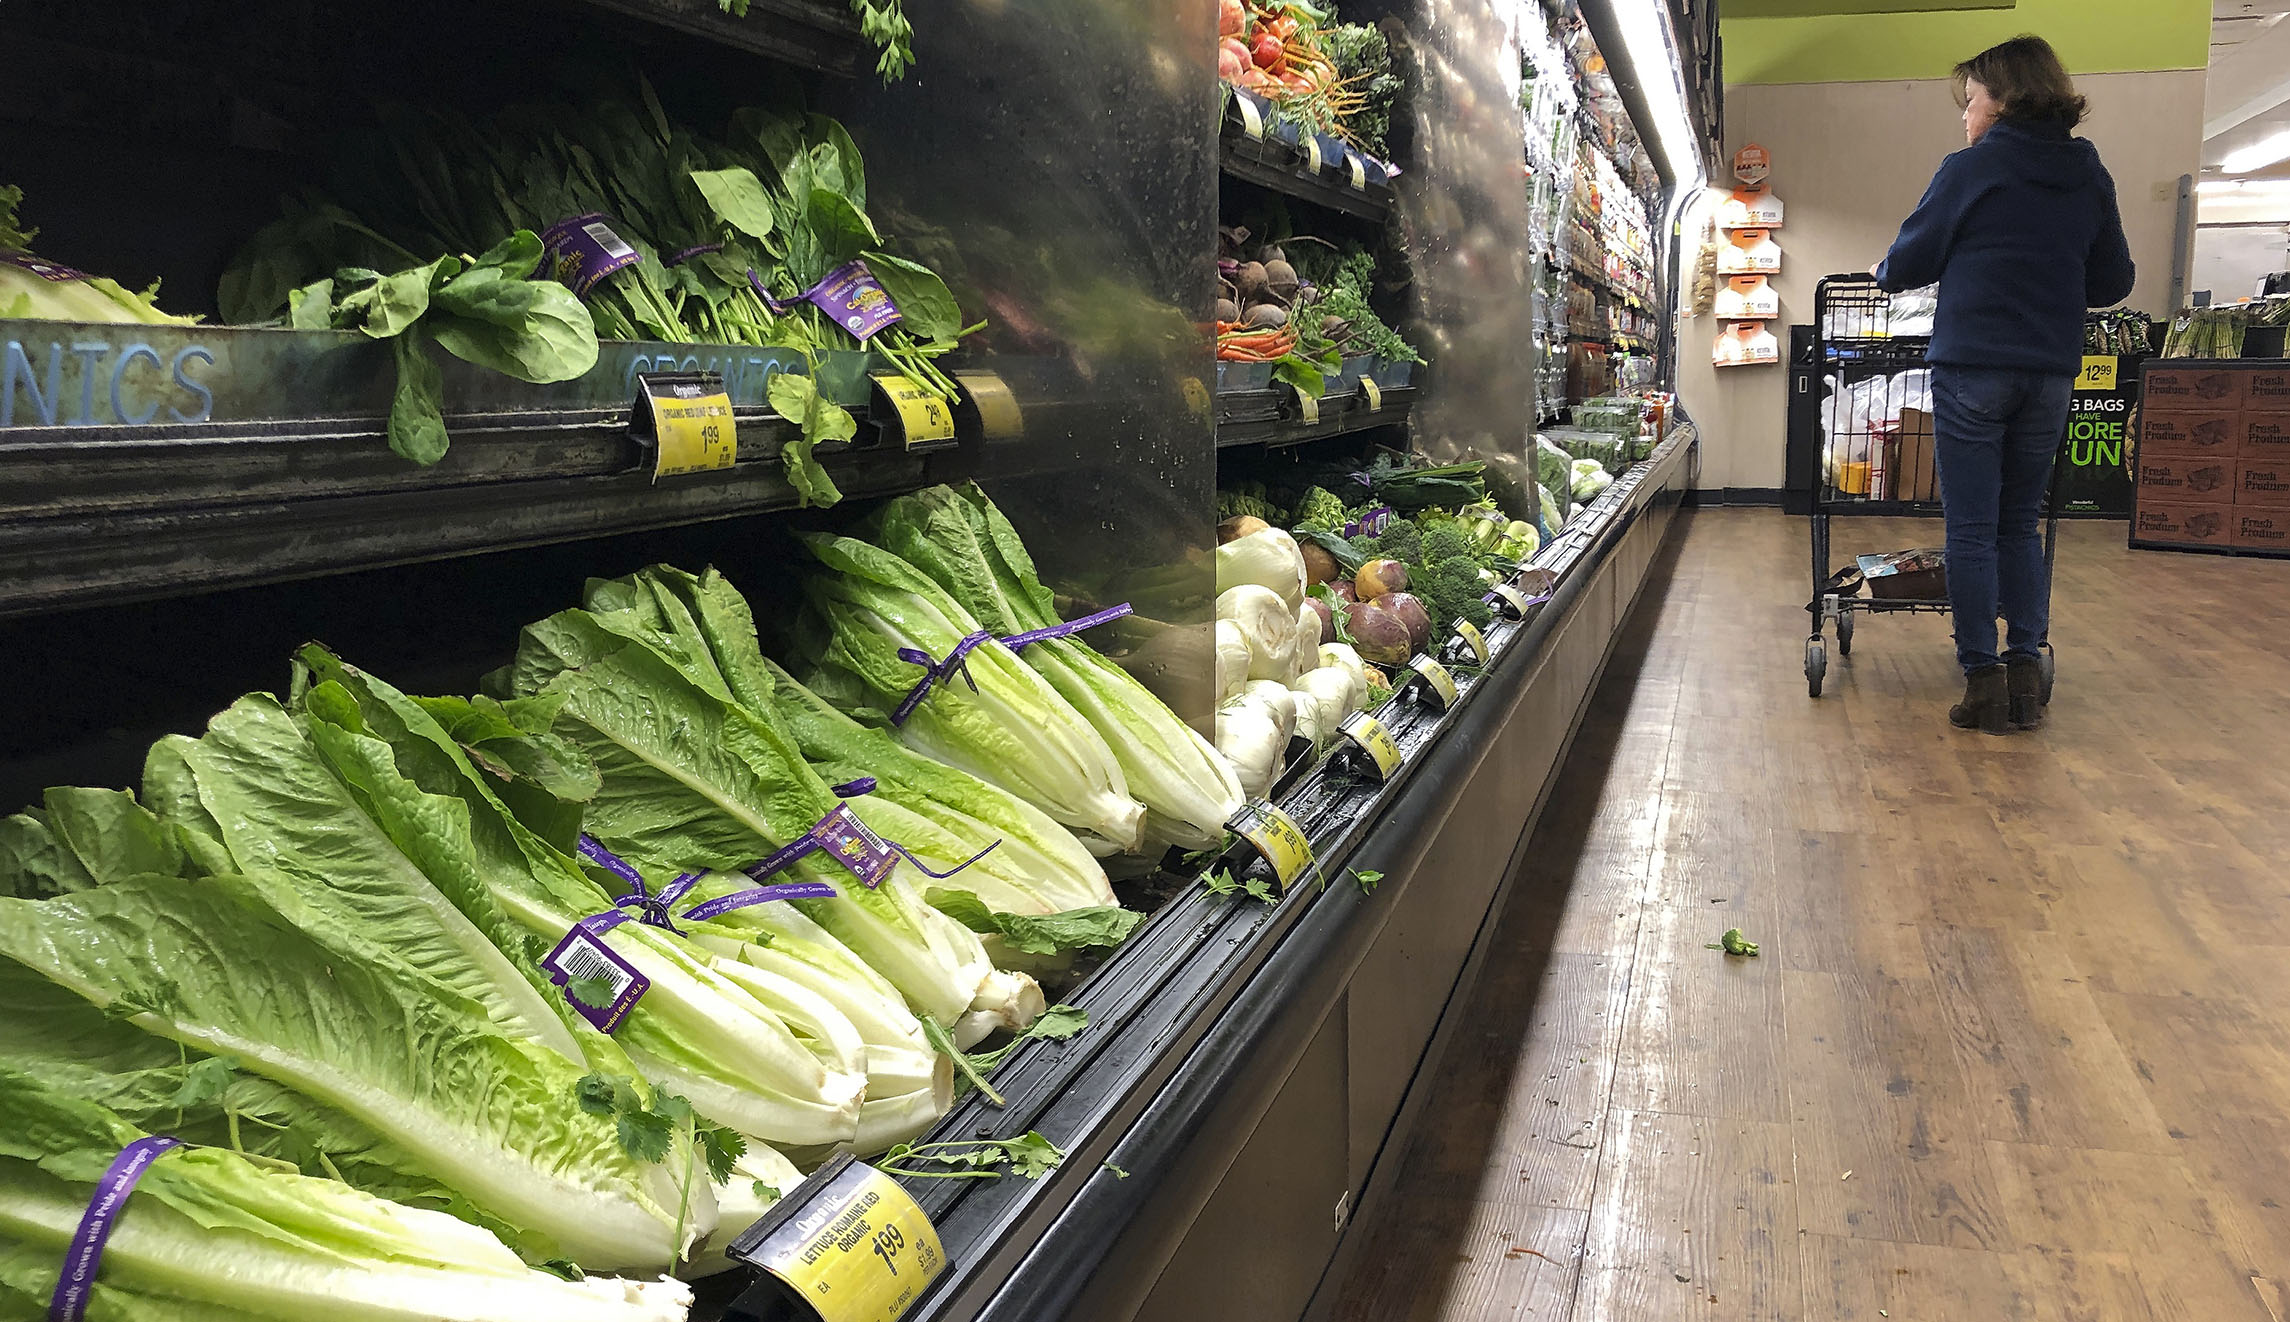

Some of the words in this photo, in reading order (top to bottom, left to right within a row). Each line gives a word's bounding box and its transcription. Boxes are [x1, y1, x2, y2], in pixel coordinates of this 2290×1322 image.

[673, 384, 702, 398] Organic
[2084, 399, 2125, 411] BAGS
[2075, 412, 2101, 421] HAVE
[2068, 421, 2122, 440] ORE
[2065, 440, 2121, 466] UN
[704, 903, 720, 914] Pride
[601, 1011, 620, 1033] Produit
[618, 1001, 630, 1013] des
[72, 1245, 94, 1282] Grown
[87, 1220, 103, 1243] with
[95, 1192, 118, 1217] Pride
[112, 1174, 129, 1192] and
[800, 1229, 838, 1266] LETTUCE
[833, 1202, 869, 1236] ROMAINE
[862, 1191, 880, 1209] RED
[837, 1219, 872, 1253] ORGANIC
[915, 1238, 925, 1251] ea
[917, 1246, 935, 1268] $1.99
[817, 1281, 831, 1294] EA
[888, 1300, 899, 1315] PLU
